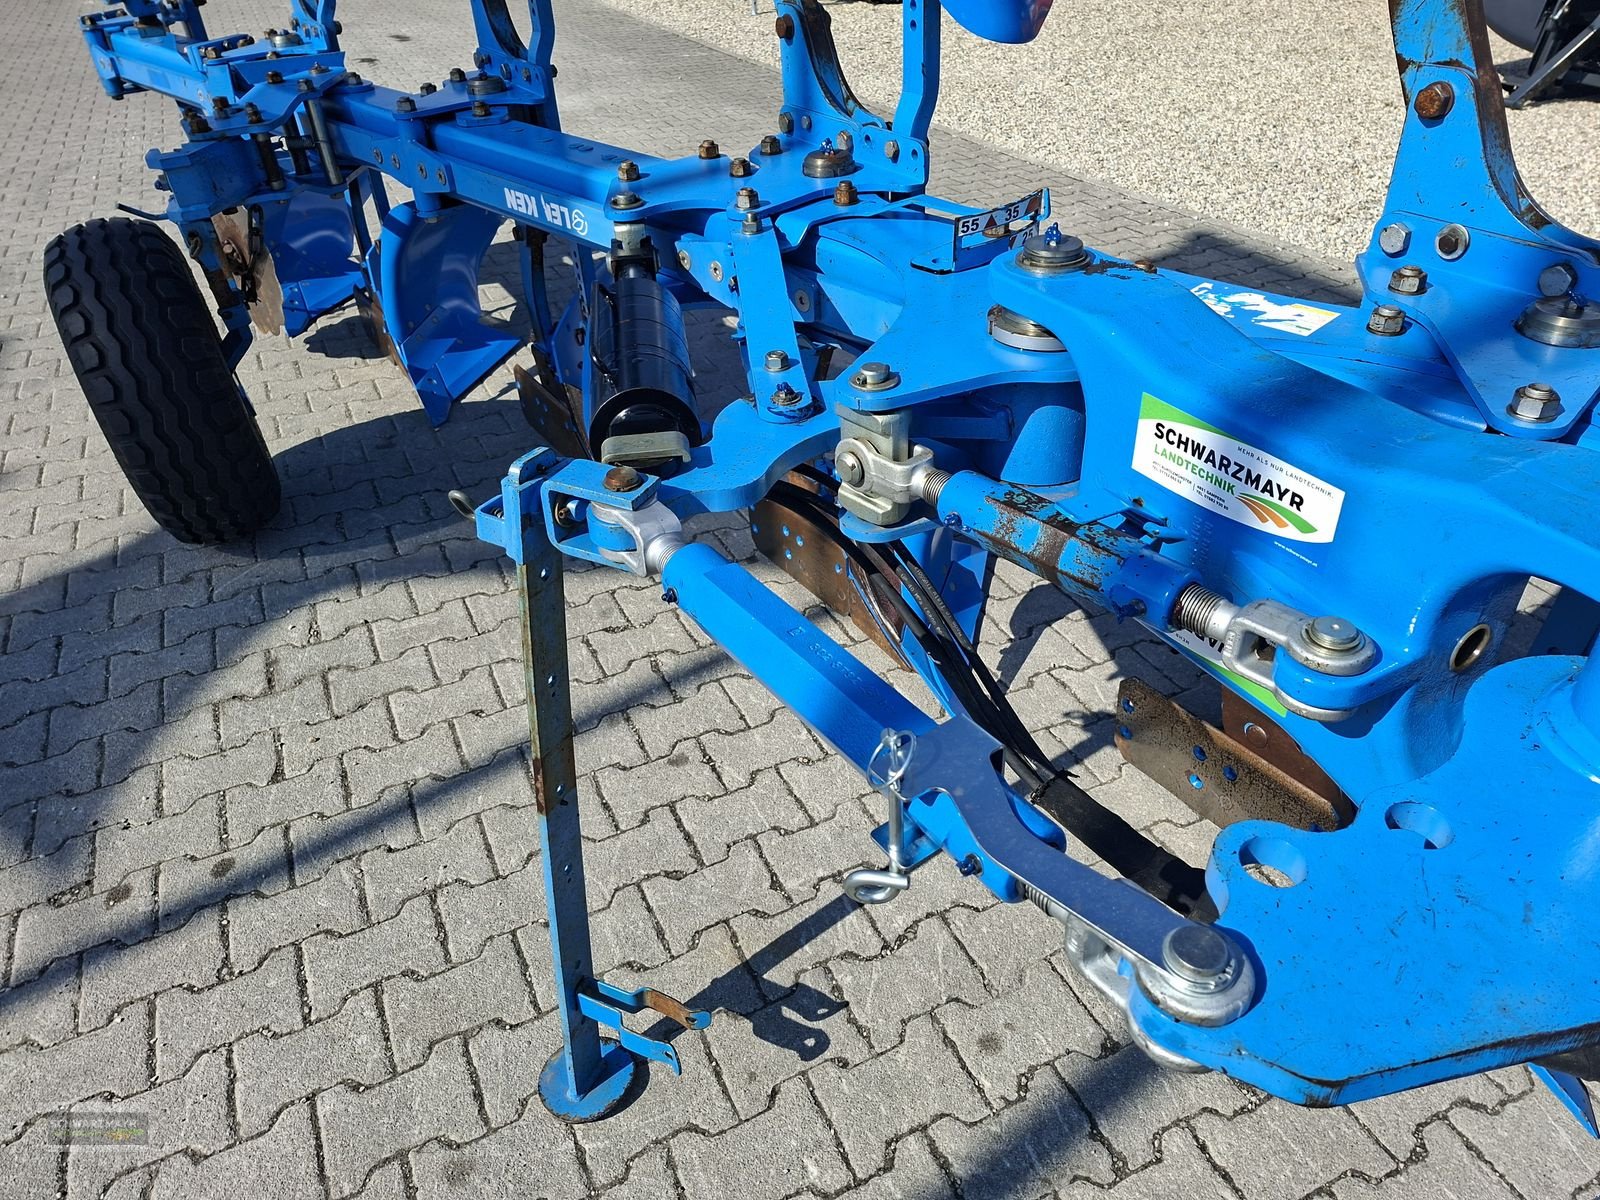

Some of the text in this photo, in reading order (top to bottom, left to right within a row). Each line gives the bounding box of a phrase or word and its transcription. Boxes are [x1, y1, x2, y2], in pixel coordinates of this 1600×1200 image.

[960, 205, 1020, 234] 55 35
[1154, 422, 1304, 512] SCHWARZMAYR
[1154, 443, 1236, 496] LANDTECHNIK
[1237, 446, 1255, 458] MEHR
[1256, 456, 1268, 466] ALS
[1270, 463, 1284, 473] NUR
